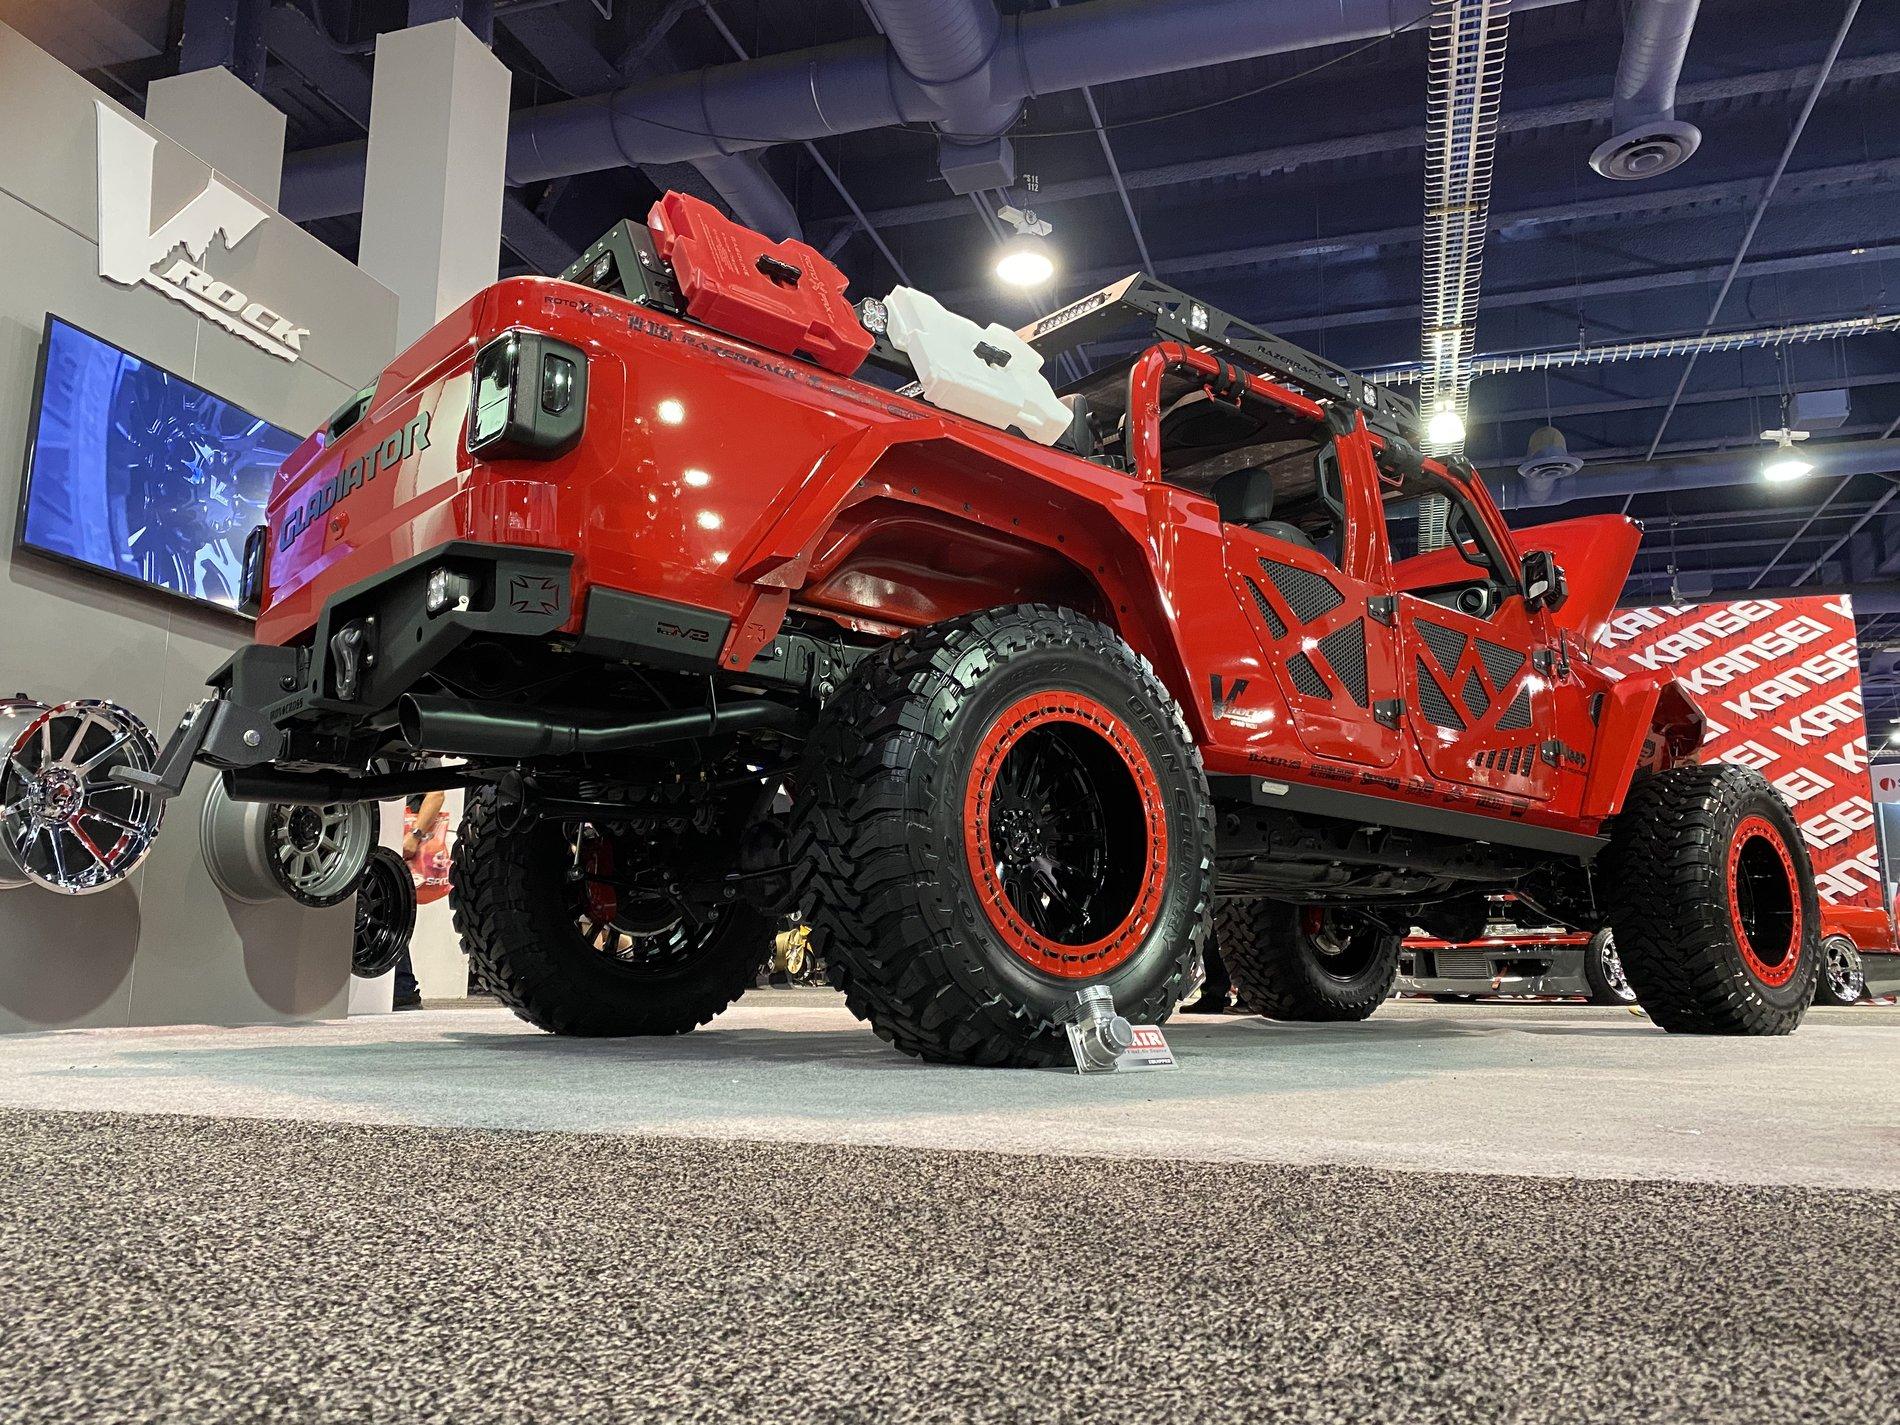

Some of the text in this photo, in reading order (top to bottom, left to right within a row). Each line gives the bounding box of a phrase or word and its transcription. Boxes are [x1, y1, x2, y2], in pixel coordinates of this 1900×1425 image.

[161, 258, 310, 352] ROCK
[280, 410, 433, 554] GLADIATOR
[1628, 600, 1784, 671] KANSEI
[1676, 615, 1834, 695] KANSEI
[1721, 638, 1858, 720] KANSE
[1771, 685, 1864, 747] KAN
[1127, 695, 1195, 945] OPEN COUNTRY
[1131, 1032, 1163, 1046] AIR
